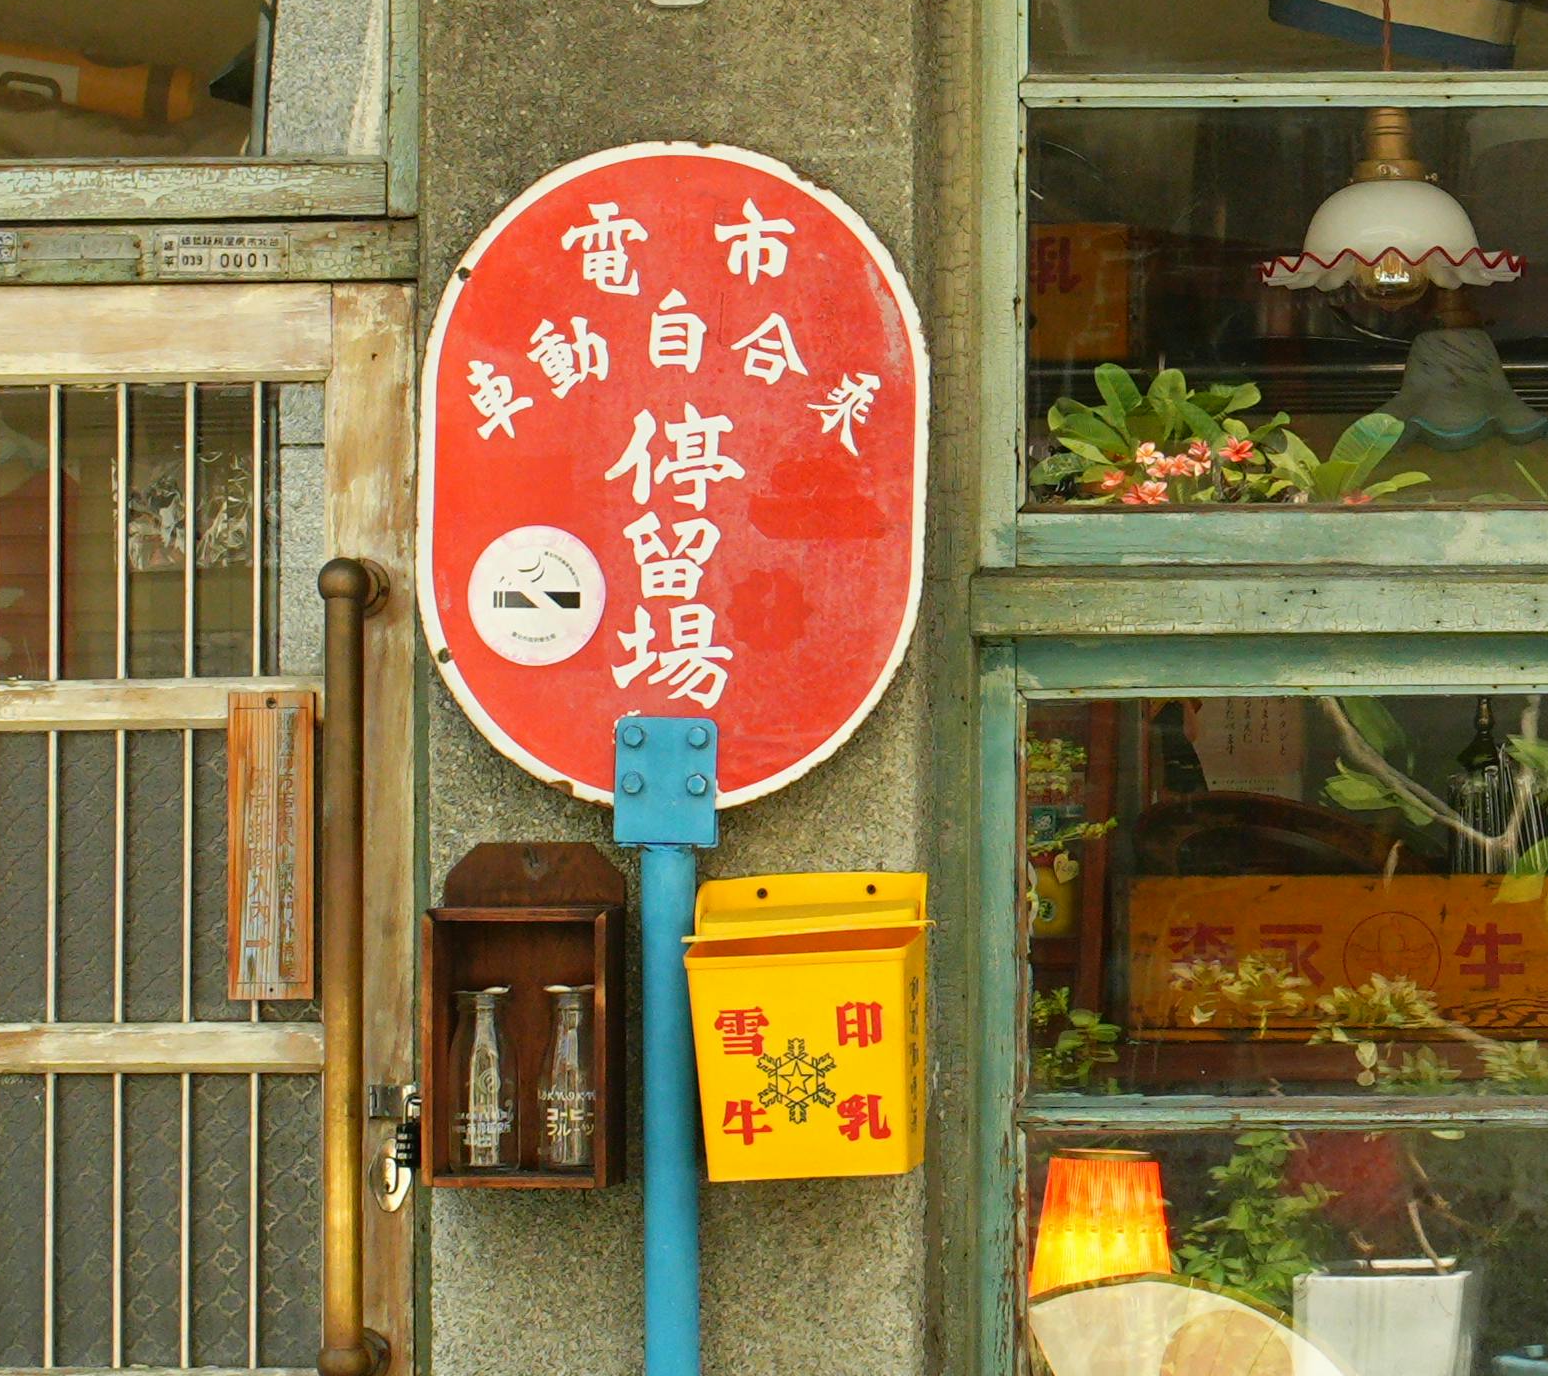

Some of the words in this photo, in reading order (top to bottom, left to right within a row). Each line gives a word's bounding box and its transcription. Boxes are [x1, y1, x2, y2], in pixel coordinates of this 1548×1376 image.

[220, 253, 270, 268] 0001
[604, 402, 746, 710] 停留場
[714, 1000, 883, 1057] 雪印
[722, 1093, 892, 1147] 牛乳
